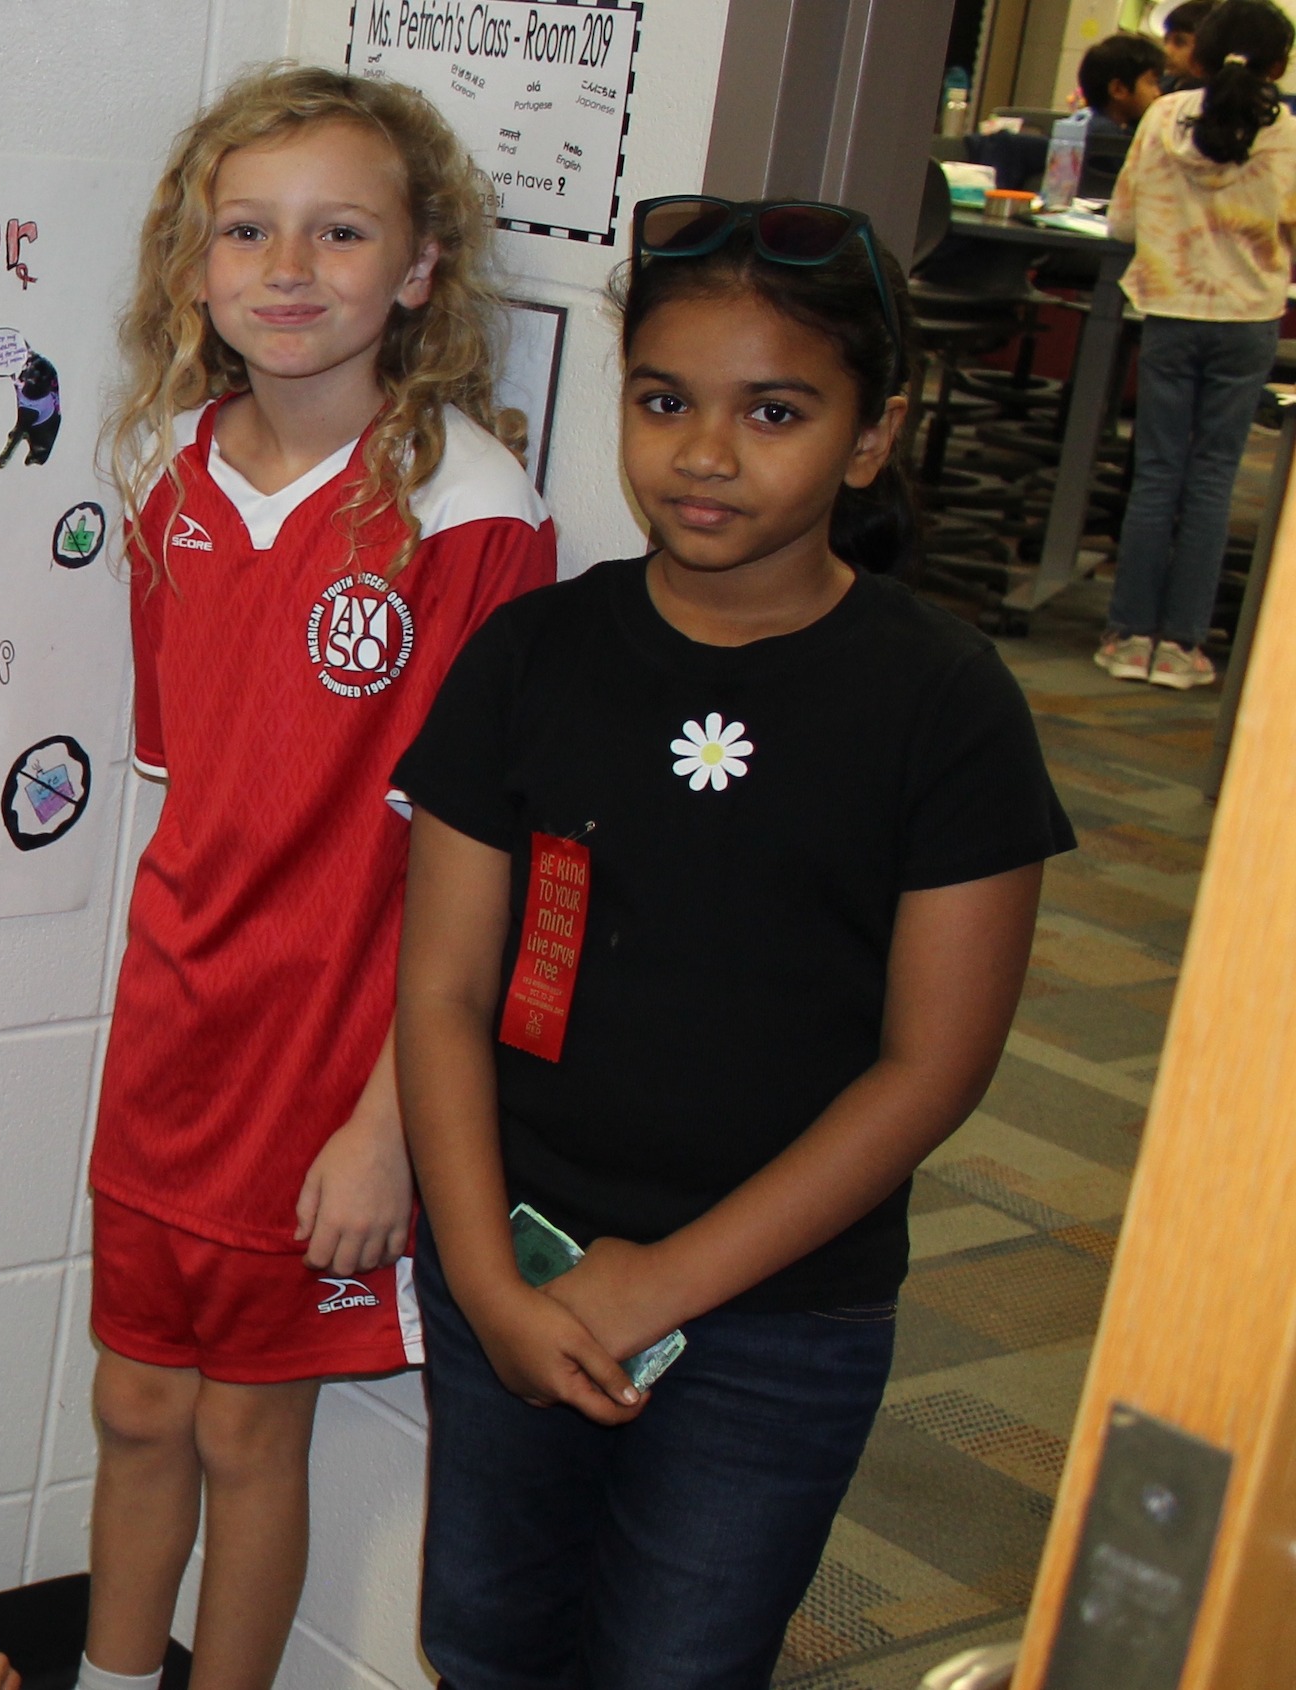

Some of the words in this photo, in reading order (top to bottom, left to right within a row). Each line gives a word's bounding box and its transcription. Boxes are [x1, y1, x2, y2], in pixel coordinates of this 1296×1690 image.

[367, 0, 392, 48] Ms.
[396, 0, 464, 54] Petrich's
[467, 4, 512, 58] Class
[523, 10, 578, 64] Room
[578, 12, 615, 68] 209
[450, 80, 476, 100] Korean
[526, 80, 542, 93] olá
[580, 78, 618, 100] こんにちは
[513, 99, 553, 112] Portugese
[575, 94, 616, 116] Japanese
[497, 142, 517, 156] Hindi
[562, 141, 584, 157] Hello
[556, 154, 582, 172] English
[491, 171, 512, 185] we
[516, 170, 552, 191] have
[556, 176, 566, 196] 9
[171, 536, 213, 552] SCORE
[307, 603, 326, 664] AMERICAN
[322, 575, 354, 602] YOUTH
[357, 572, 389, 593] SOCCER
[386, 592, 414, 668] ORGANIZATION
[317, 669, 362, 698] FOUNDED
[364, 676, 392, 696] 1964
[540, 851, 554, 876] BE
[539, 878, 554, 902] TO
[555, 886, 581, 912] YOUR
[318, 1295, 376, 1314] SCORE
